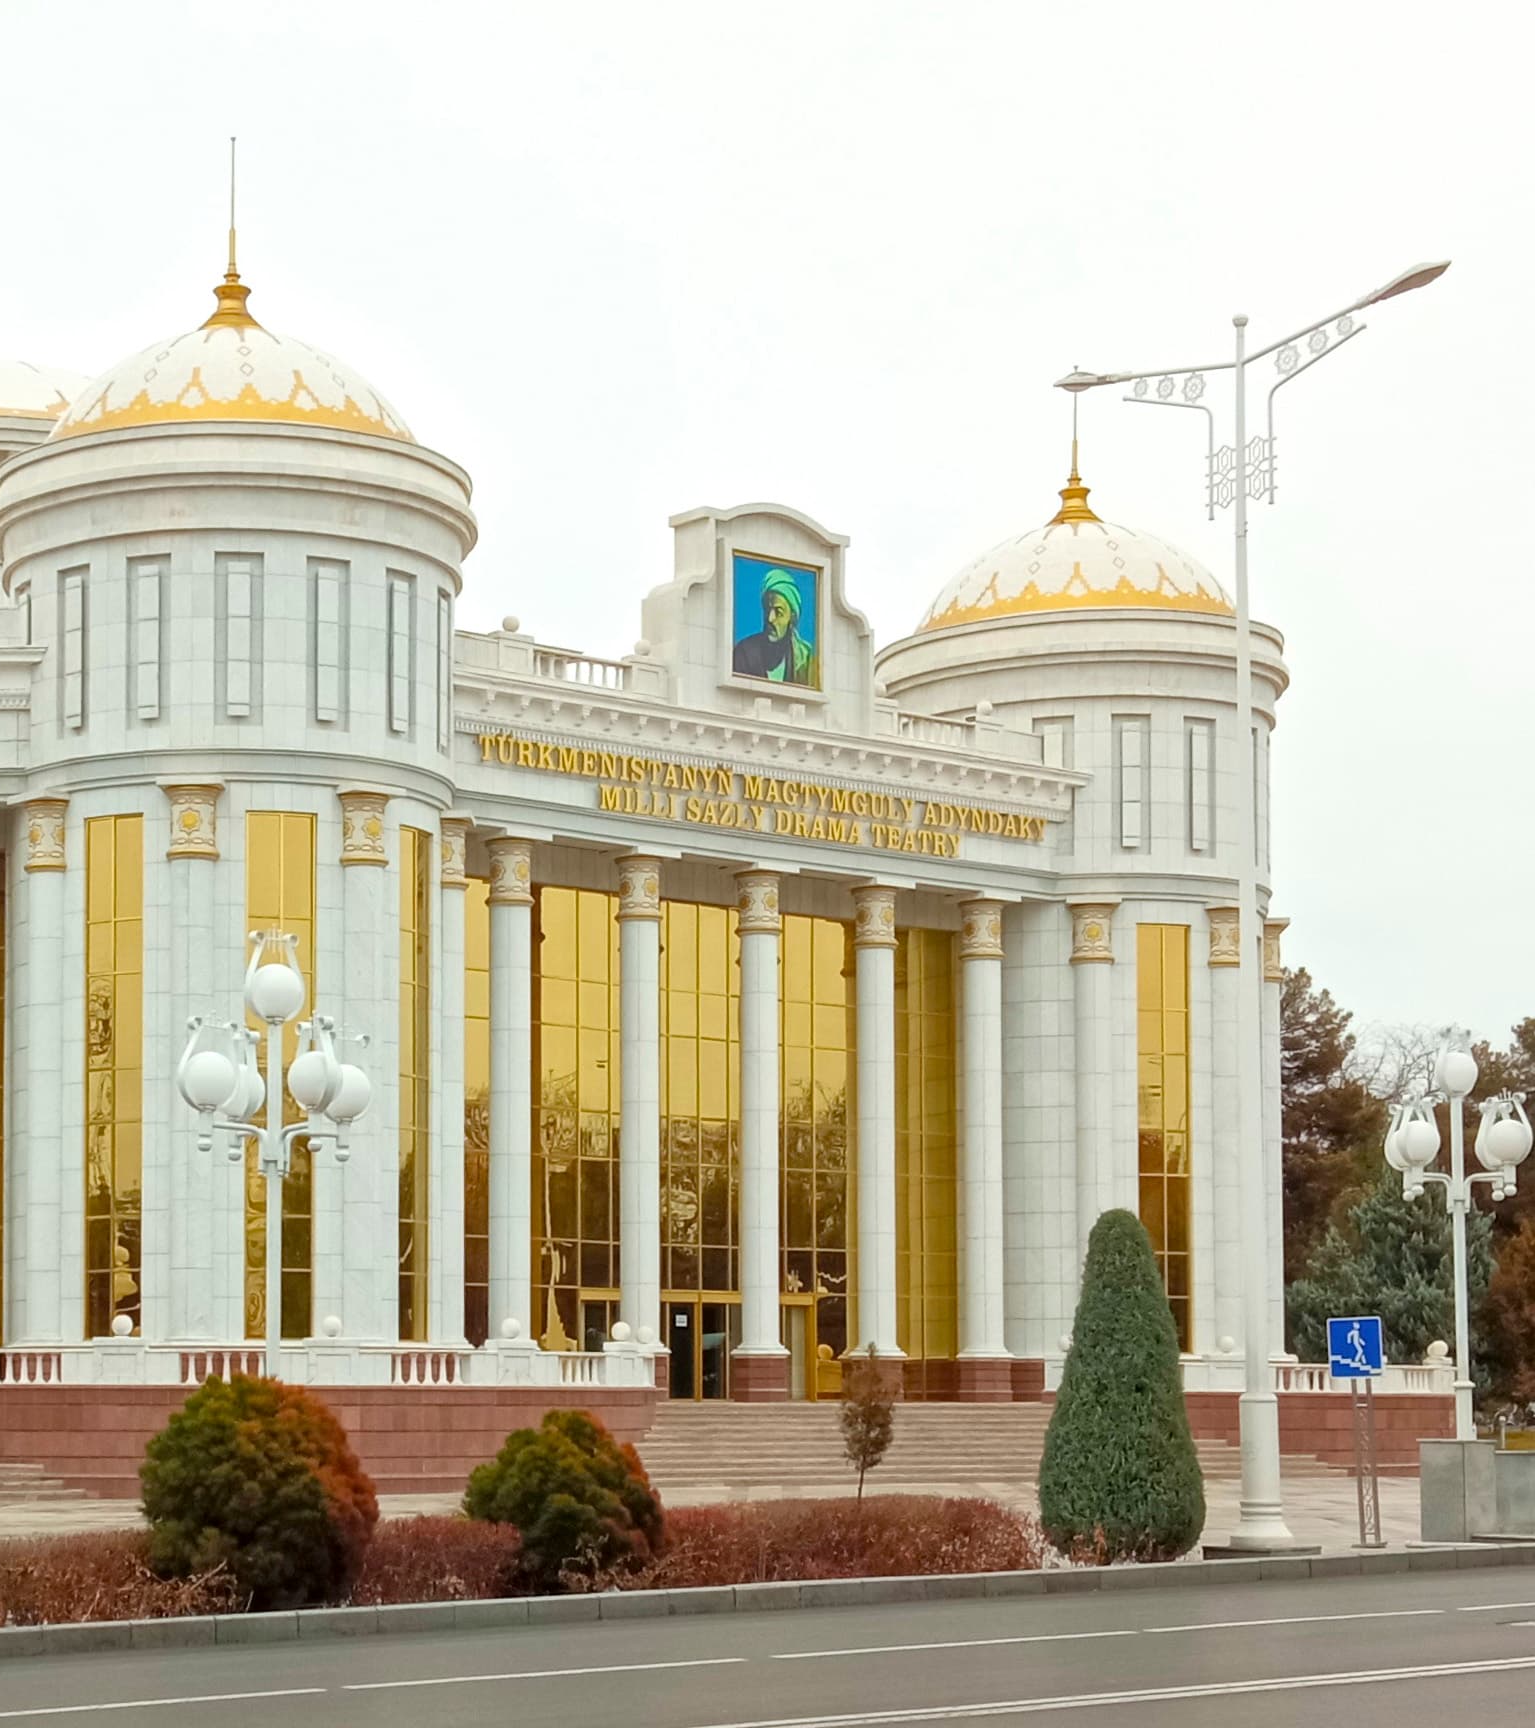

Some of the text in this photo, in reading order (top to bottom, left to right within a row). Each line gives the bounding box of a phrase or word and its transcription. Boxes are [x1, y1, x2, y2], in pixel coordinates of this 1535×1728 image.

[599, 783, 962, 859] MILLI SAZLY DRAMA TEATRY
[743, 774, 914, 823] MAGTYMGULY
[923, 801, 1048, 842] ADYNDAKY
